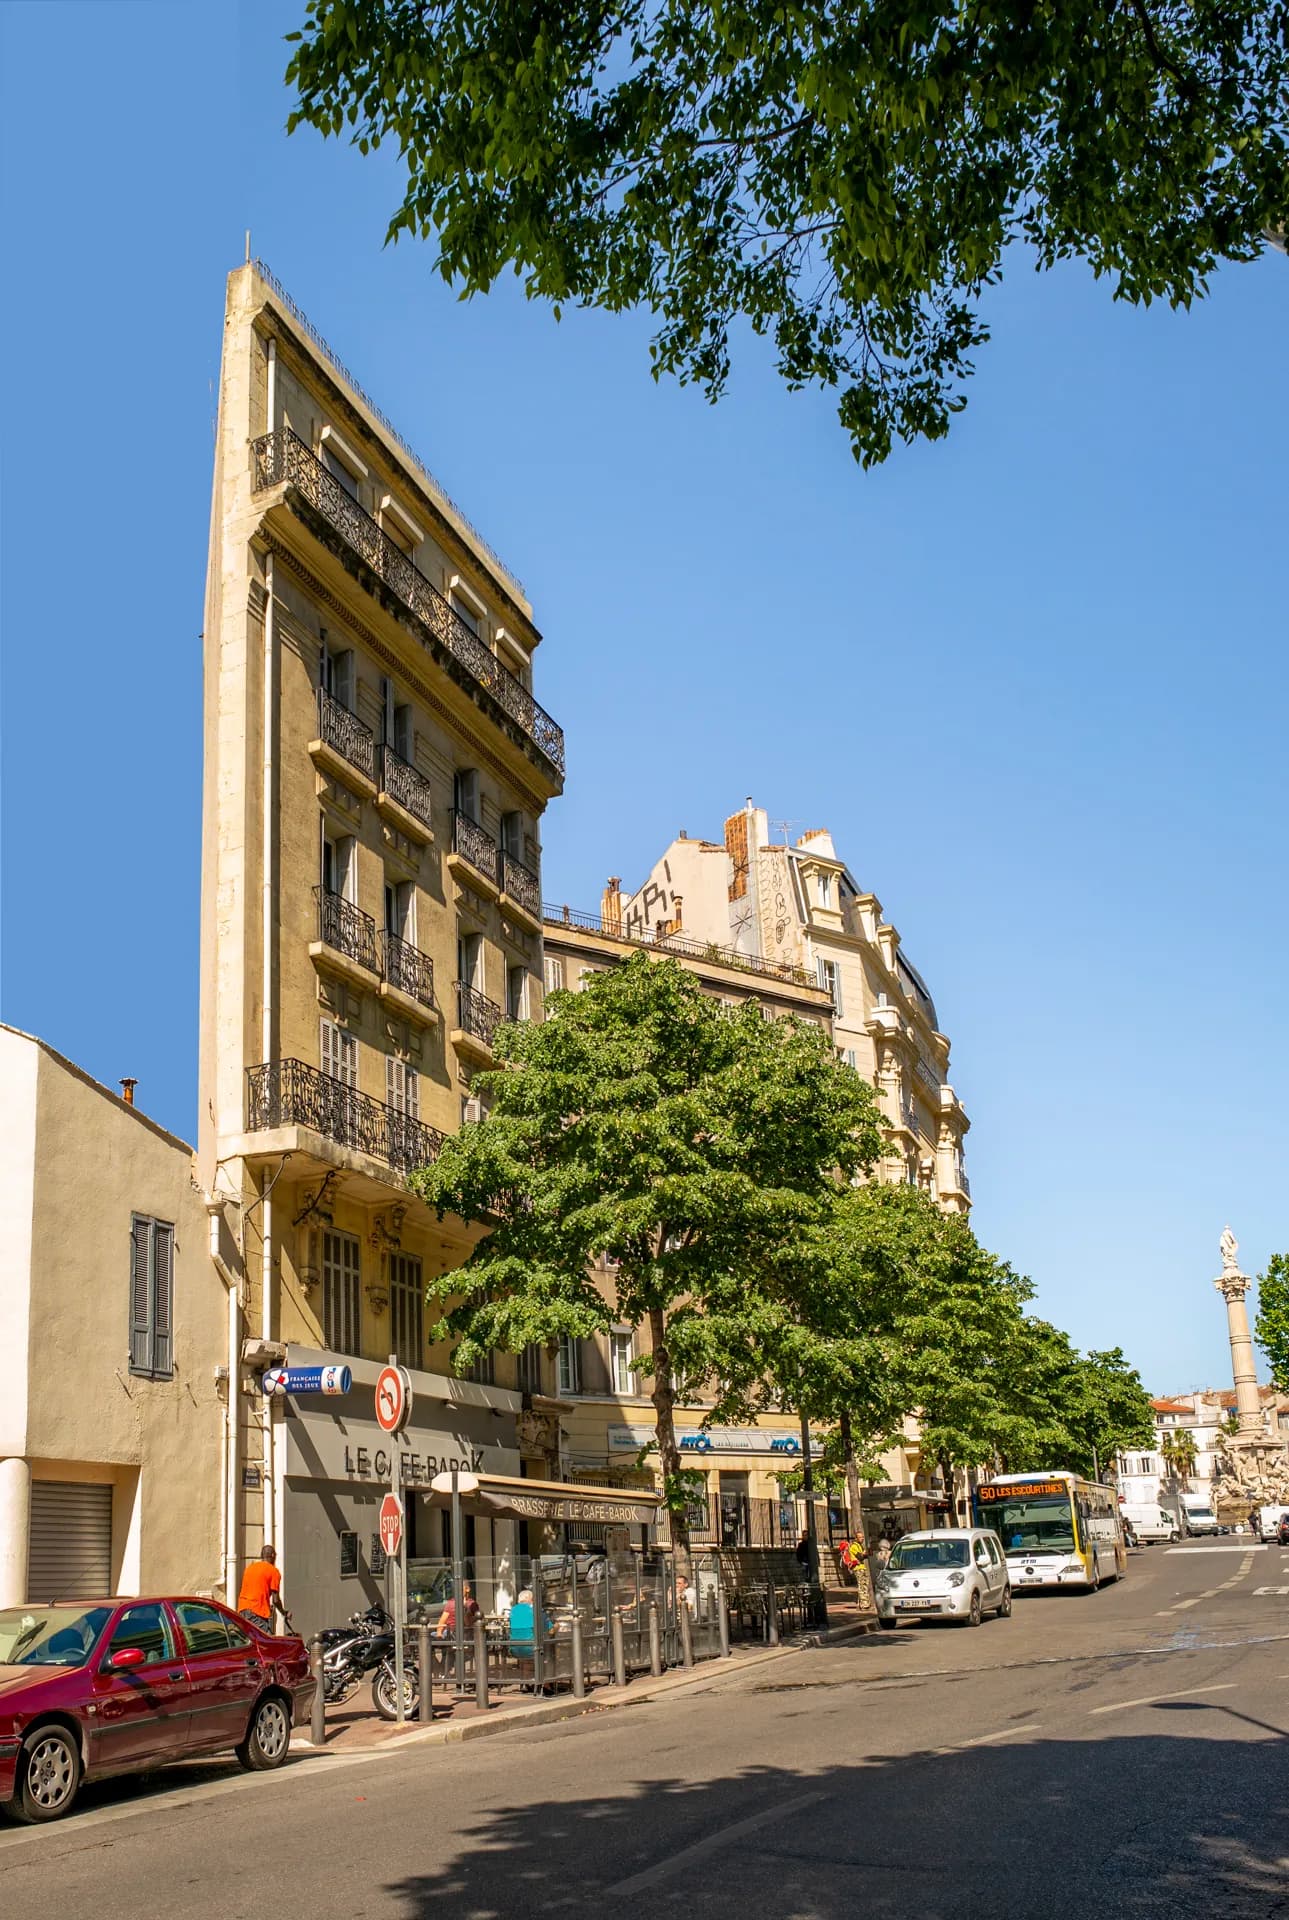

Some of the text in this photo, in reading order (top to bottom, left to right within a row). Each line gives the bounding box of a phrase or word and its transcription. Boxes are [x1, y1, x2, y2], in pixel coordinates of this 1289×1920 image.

[344, 1445, 367, 1474] LE
[980, 1487, 995, 1499] 50
[996, 1486, 1011, 1497] LES
[569, 1503, 580, 1517] LE
[382, 1514, 399, 1534] STOP
